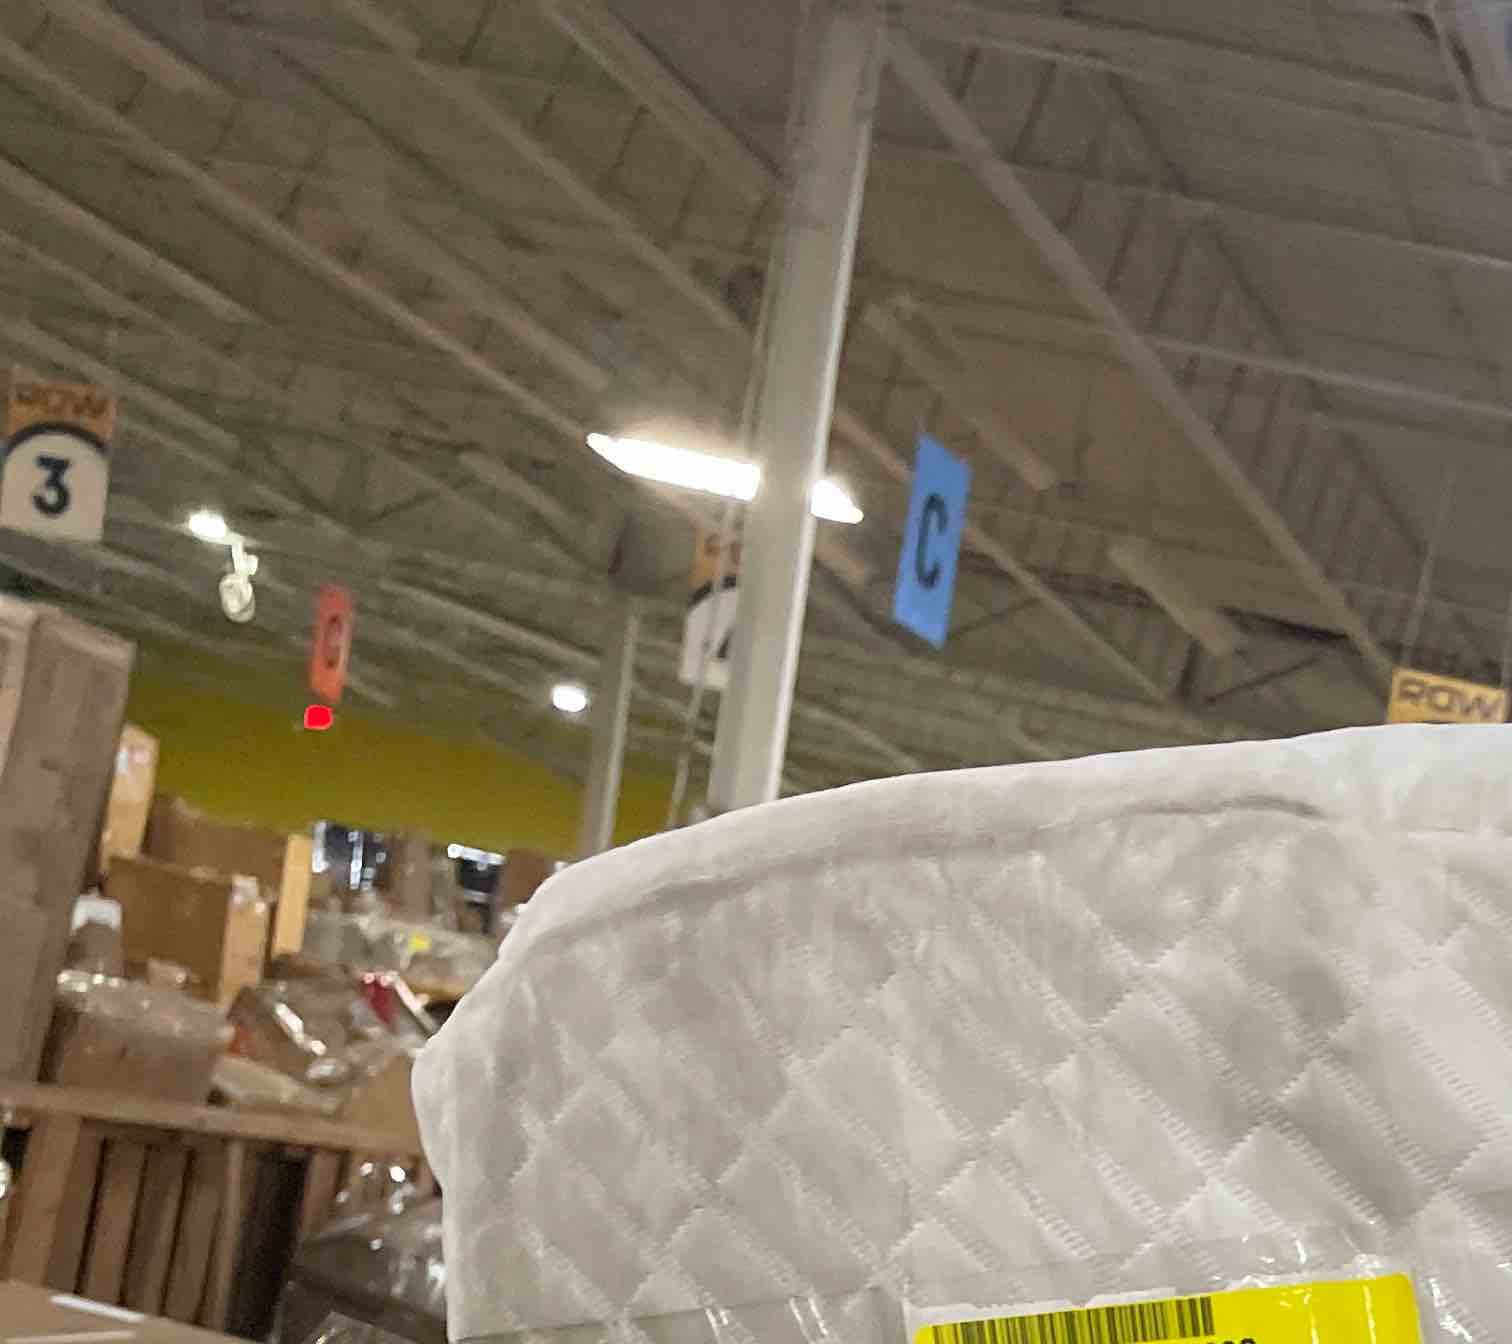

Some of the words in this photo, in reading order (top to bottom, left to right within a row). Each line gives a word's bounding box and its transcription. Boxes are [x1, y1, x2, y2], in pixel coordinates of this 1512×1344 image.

[32, 455, 72, 520] 3
[915, 492, 949, 590] C
[1399, 678, 1502, 719] ROW
